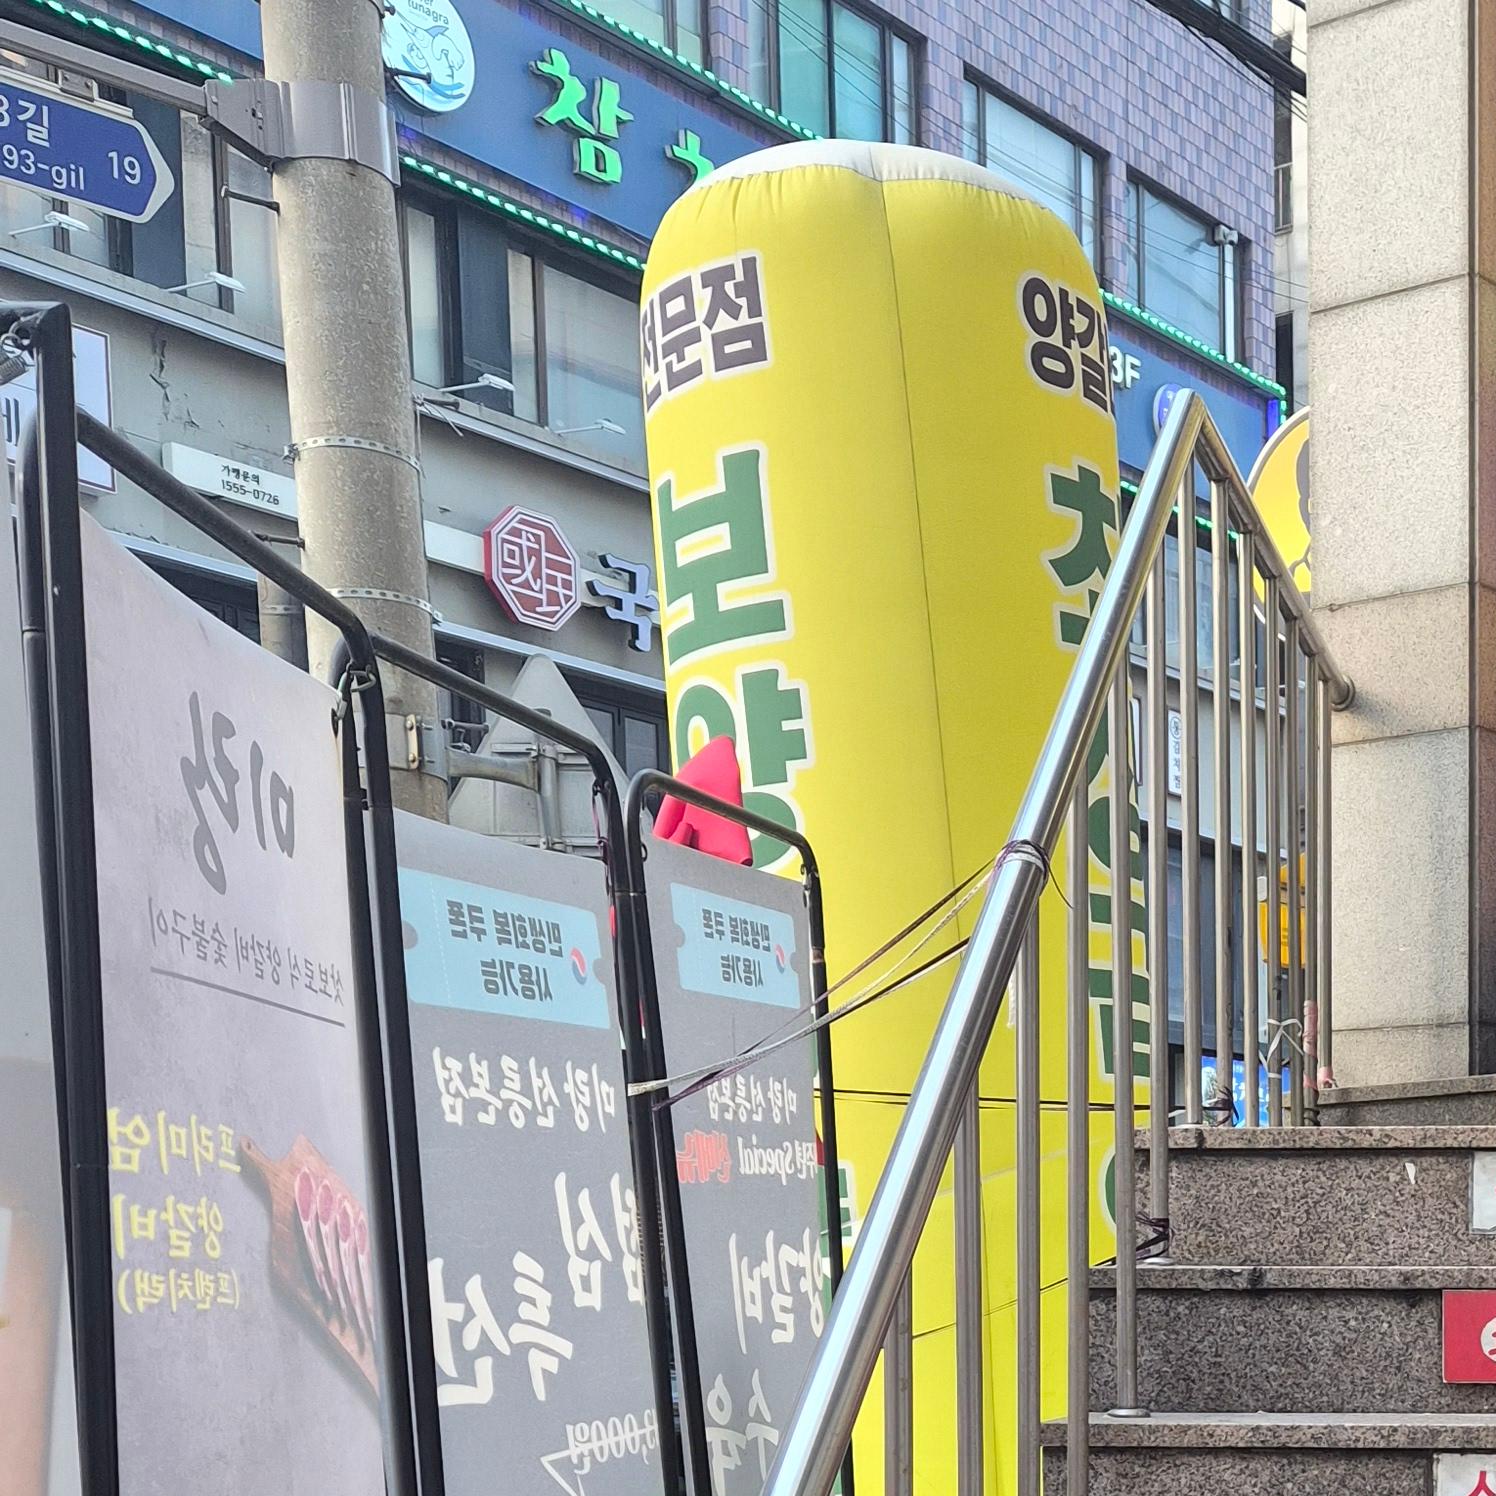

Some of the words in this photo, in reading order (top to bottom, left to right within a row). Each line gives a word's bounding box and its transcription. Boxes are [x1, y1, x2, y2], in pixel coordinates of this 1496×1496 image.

[107, 151, 141, 185] 19
[1022, 276, 1115, 416] 양갈
[221, 479, 280, 505] 1555-0726
